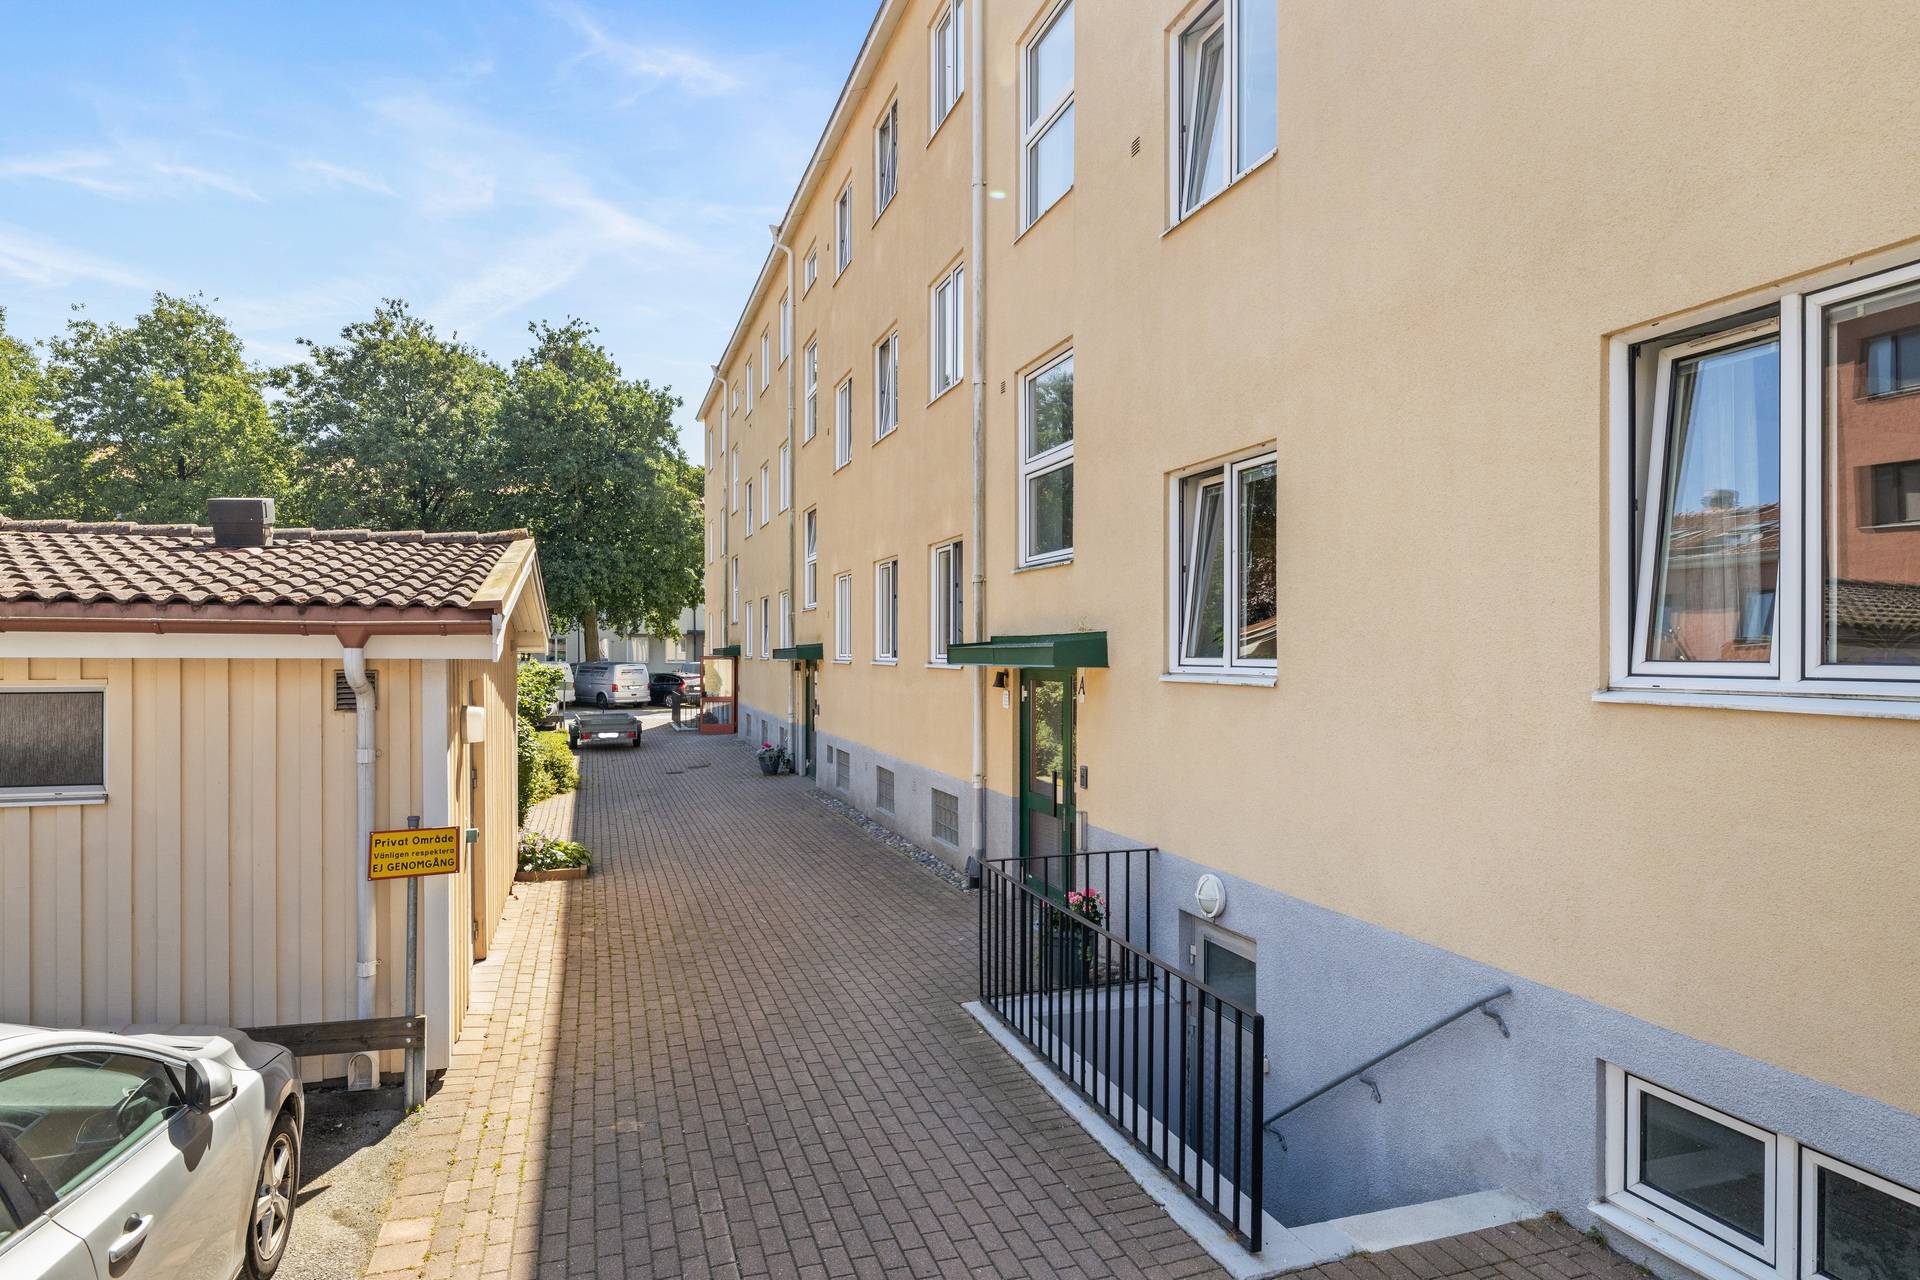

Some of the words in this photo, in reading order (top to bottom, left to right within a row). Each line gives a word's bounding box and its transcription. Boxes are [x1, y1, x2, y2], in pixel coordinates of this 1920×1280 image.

[1078, 676, 1085, 695] A
[374, 837, 408, 848] Privat
[412, 834, 454, 844] Område
[373, 850, 409, 859] Vänligen
[411, 848, 454, 857] respektera
[373, 864, 383, 872] EJ
[387, 857, 455, 871] GENOMGÅNG
